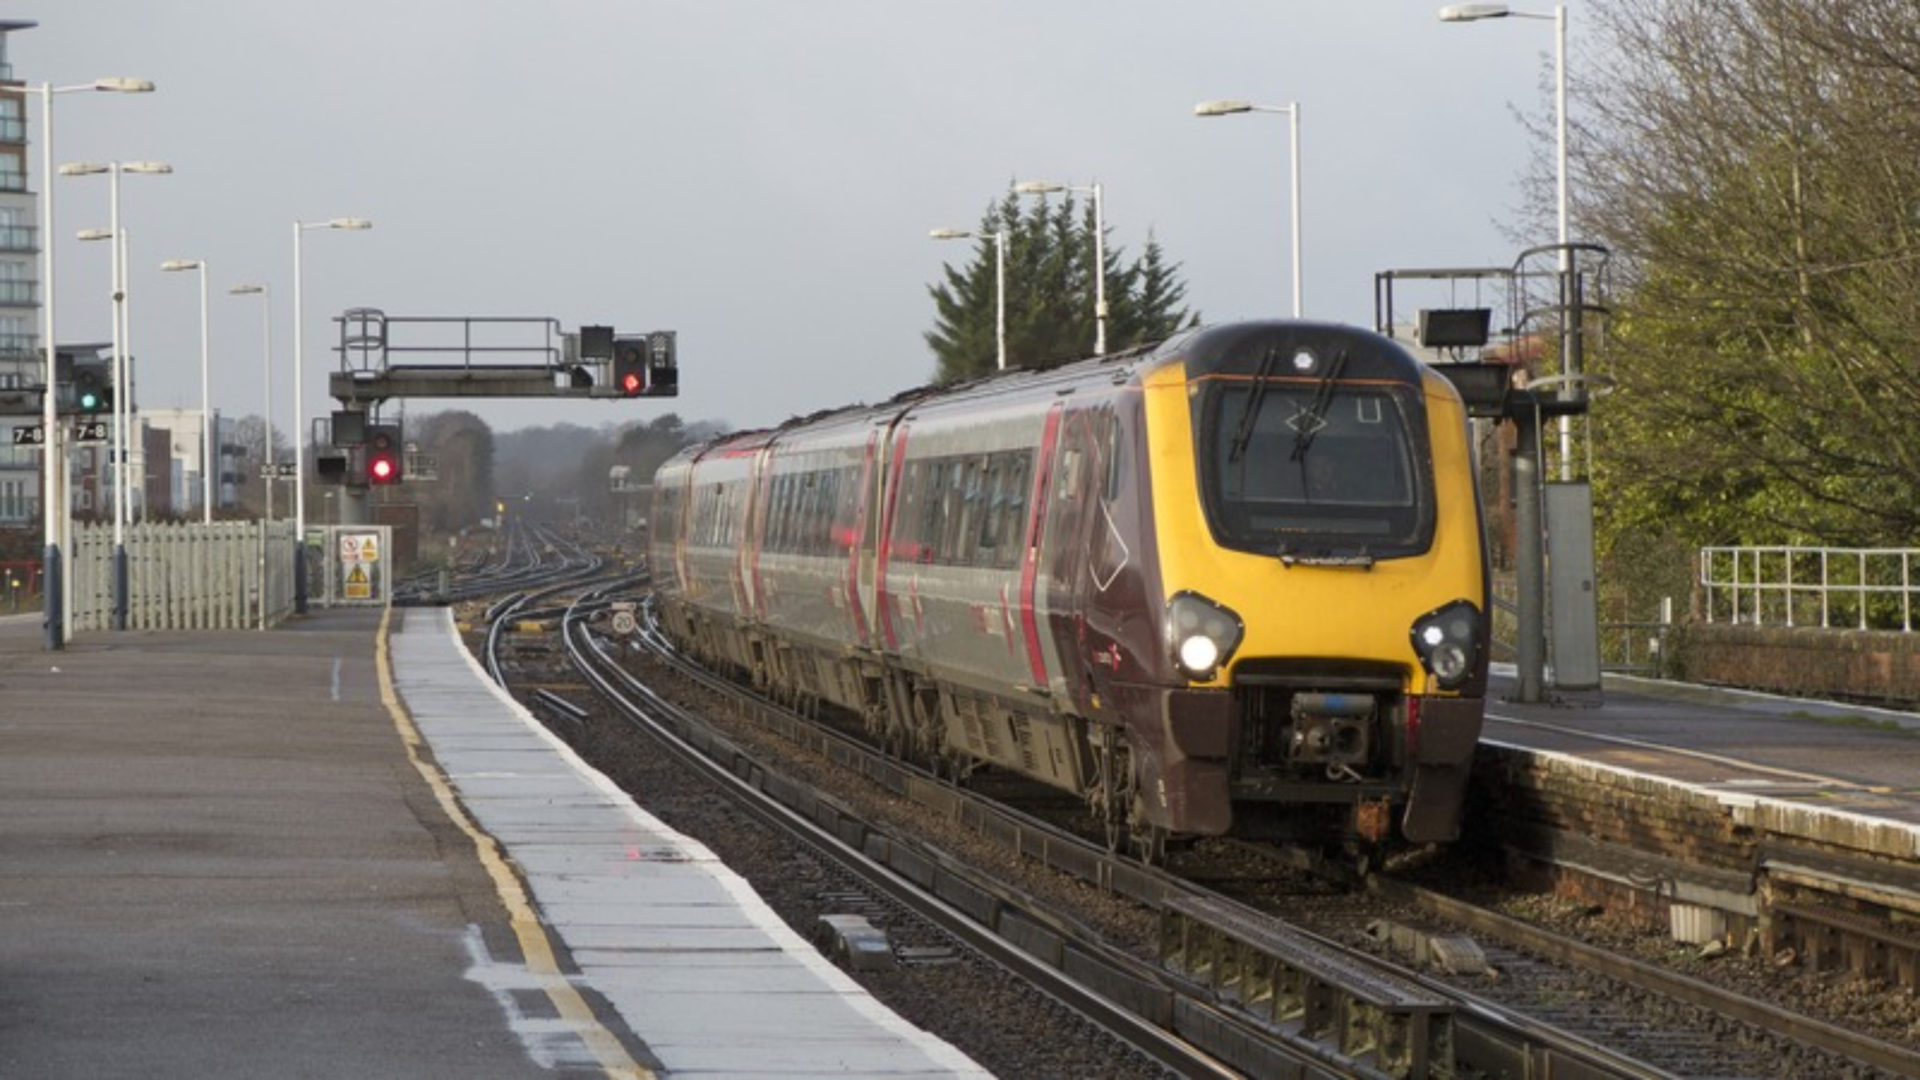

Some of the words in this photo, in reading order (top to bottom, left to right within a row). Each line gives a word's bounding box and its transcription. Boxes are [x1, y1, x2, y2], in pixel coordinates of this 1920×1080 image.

[15, 429, 42, 442] 7-8
[78, 424, 104, 438] 7-8
[617, 616, 631, 629] 20
